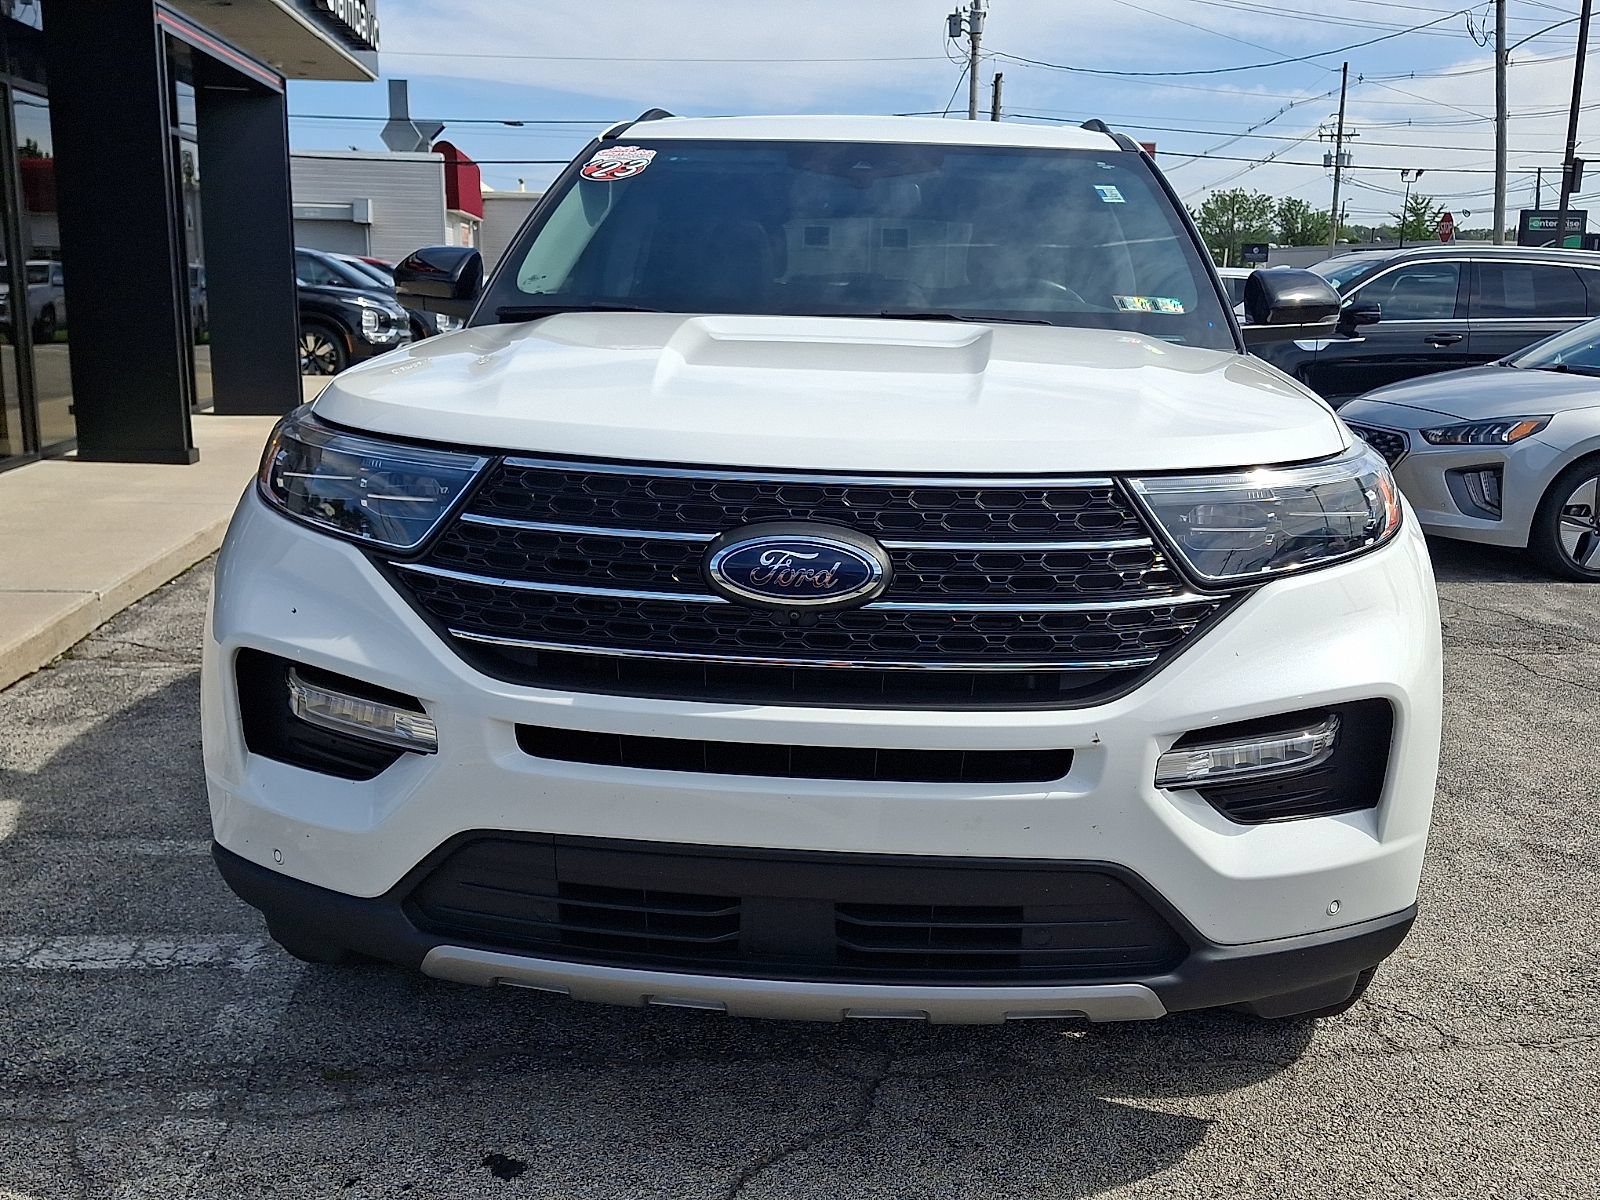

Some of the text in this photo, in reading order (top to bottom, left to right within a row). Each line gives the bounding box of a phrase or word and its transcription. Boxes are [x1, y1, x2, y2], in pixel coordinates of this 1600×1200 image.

[1440, 221, 1452, 234] STOP
[1531, 219, 1580, 228] enterise
[750, 549, 842, 589] Ford
